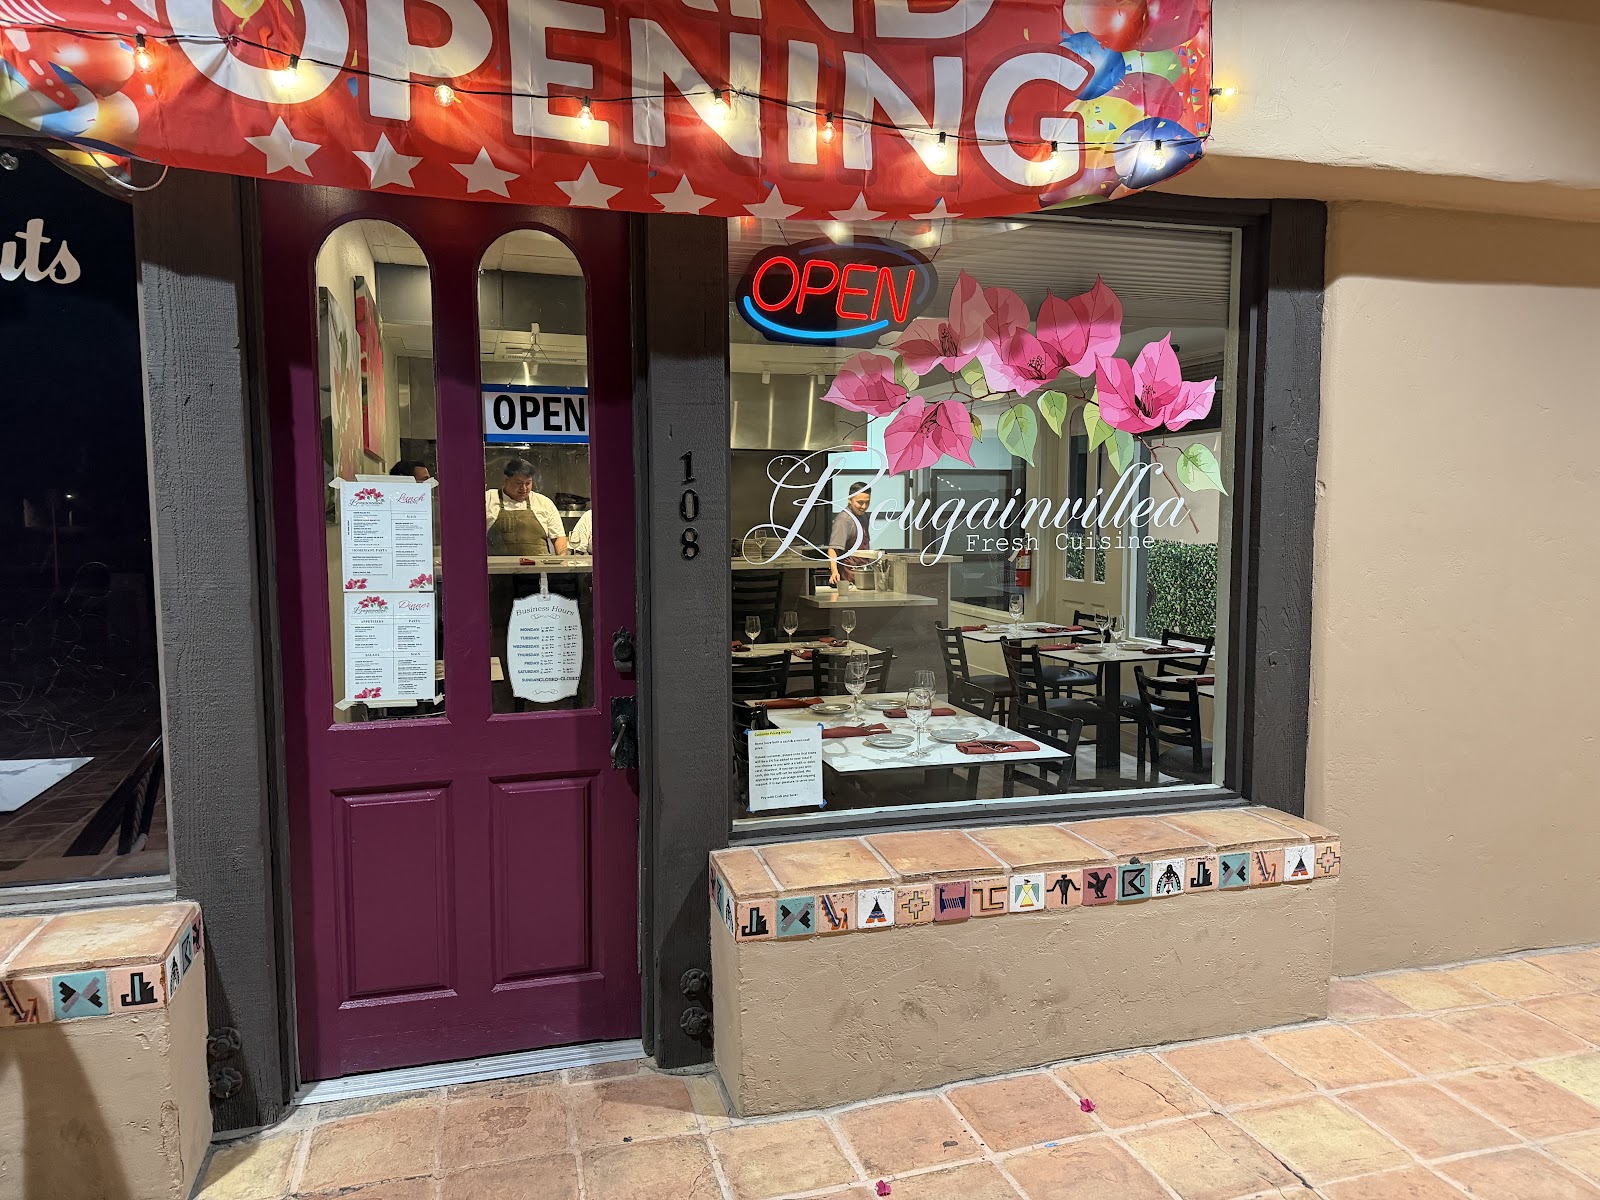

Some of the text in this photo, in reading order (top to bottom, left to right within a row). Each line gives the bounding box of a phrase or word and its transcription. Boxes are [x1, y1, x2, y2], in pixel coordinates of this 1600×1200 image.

[164, 0, 1089, 187] OPENING
[753, 256, 917, 323] OPEN
[493, 394, 586, 432] OPEN
[396, 492, 426, 504] Lunch
[742, 445, 1190, 567] Bougainvillea
[966, 531, 1156, 553] Fresh Cuisine
[398, 600, 431, 610] Dinner
[516, 605, 575, 616] Business Hours
